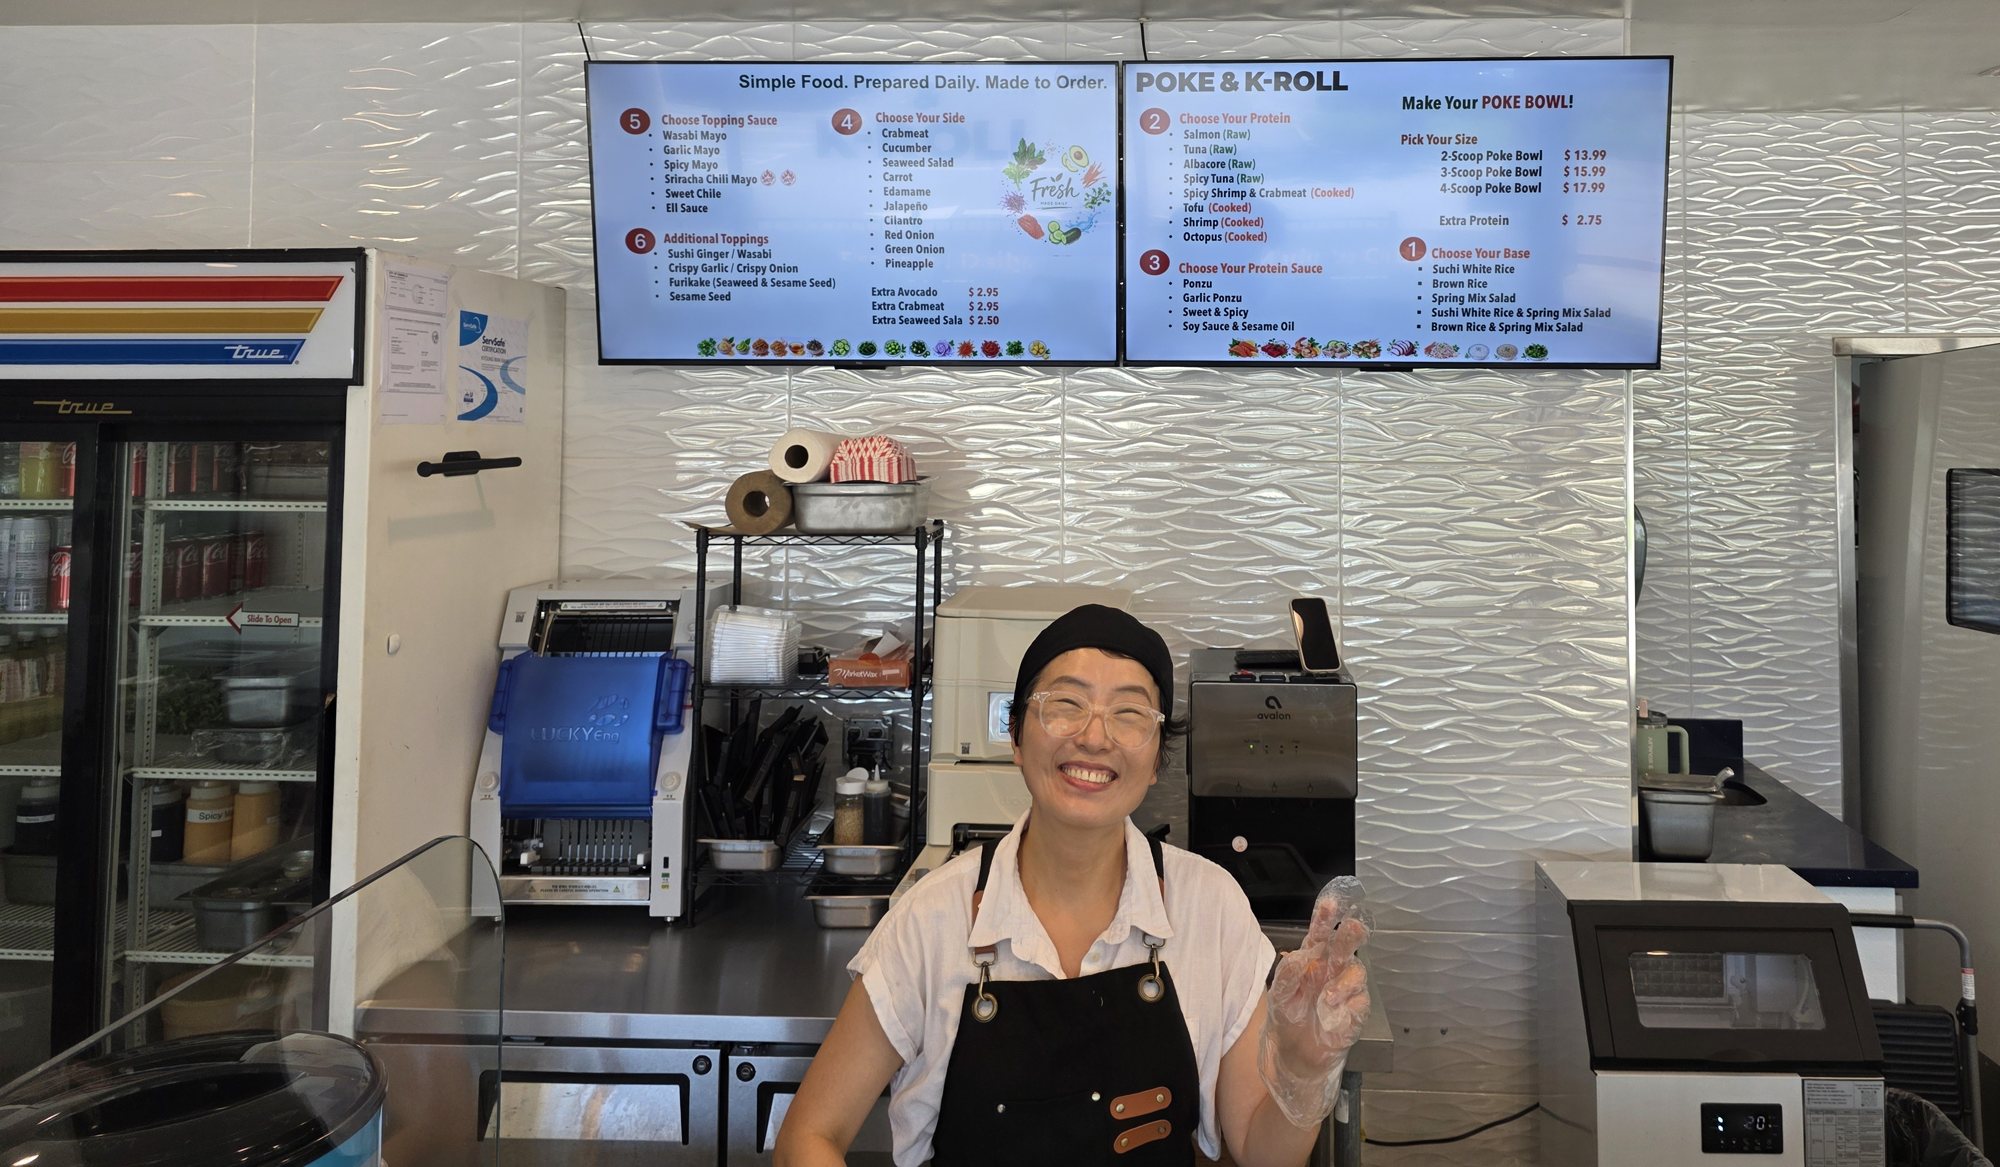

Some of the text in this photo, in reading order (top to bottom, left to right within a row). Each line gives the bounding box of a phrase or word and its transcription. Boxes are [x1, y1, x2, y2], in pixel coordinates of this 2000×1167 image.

[739, 74, 1107, 92] Simple Food. Prepared Daily. Made to Order.
[1136, 70, 1348, 92] POKE & K-ROLL
[1402, 94, 1574, 110] Make Your POKE BOWL!
[630, 113, 640, 129] 5
[662, 115, 778, 128] Choose Topping Sauce
[841, 114, 853, 129] 4
[876, 112, 965, 123] Choose Your Side
[1149, 114, 1160, 129] 2
[1180, 112, 1290, 124] Choose Your Protein
[663, 130, 726, 142] Wasabi Mayo
[882, 128, 928, 138] Crabmeat
[1184, 129, 1250, 140] Salmon (Raw)
[1401, 134, 1477, 145] Pick Your Size
[664, 145, 720, 156] Garlic Mayo
[882, 143, 931, 153] Cucumber
[1184, 144, 1237, 155] Tuna (Raw)
[1441, 149, 1606, 162] 2-Scoop Poke Bowl $ 13.99
[664, 159, 718, 171] Spicy Mayo
[883, 157, 954, 168] Seaweed Salad
[1184, 158, 1256, 170] Albacore (Raw)
[883, 172, 912, 182] Carrot
[1184, 173, 1264, 184] Spicy Tuna (Raw)
[1441, 166, 1606, 179] 3-Scoop Poke Bowl $ 15.99
[665, 174, 704, 184] Sriracha
[706, 174, 728, 184] Chili
[732, 174, 757, 186] Mayo
[666, 188, 721, 199] Sweet Chile
[884, 186, 931, 197] Edamame
[1030, 176, 1080, 200] Fresh
[1440, 182, 1605, 196] 4-Scoop Poke Bowl $ 17.99
[666, 203, 708, 213] Ell Sauce
[884, 201, 928, 212] Jalapeño
[1184, 202, 1251, 214] Tofu (Cooked)
[884, 215, 922, 226] Cilantro
[1184, 216, 1264, 228] Shrimp (Cooked)
[1440, 214, 1602, 226] Extra Protein $ 2.75
[634, 234, 646, 248] 6
[664, 233, 768, 246] Additional Toppings
[885, 230, 934, 240] Red Onion
[1184, 231, 1267, 243] Octopus (Cooked)
[668, 248, 772, 261] Sushi Ginger / Wasabi
[885, 244, 945, 254] Green Onion
[1408, 241, 1416, 257] 1
[1432, 248, 1530, 259] Choose Your Base
[886, 258, 934, 270] Pineapple
[1149, 255, 1160, 270] 3
[1179, 262, 1322, 273] Choose Your Protein Sauce
[1433, 264, 1514, 274] Suchi White Rice
[1183, 279, 1212, 288] Ponzu
[1432, 278, 1488, 288] Brown Rice
[670, 291, 731, 302] Sesame Seed
[872, 287, 998, 298] Extra Avocado $ 2.95
[1183, 292, 1242, 303] Garlic Ponzu
[1432, 292, 1516, 305] Spring Mix Salad
[1183, 306, 1248, 318] Sweet & Spicy
[872, 314, 999, 326] Extra Seaweed Sala $ 2.50
[482, 336, 505, 347] ServSafe
[224, 345, 284, 358] true
[482, 345, 506, 354] CERTIFICATION
[33, 399, 132, 414] true
[247, 614, 292, 624] Slide To Open
[1257, 711, 1291, 720] avalon
[198, 812, 222, 820] Spicy
